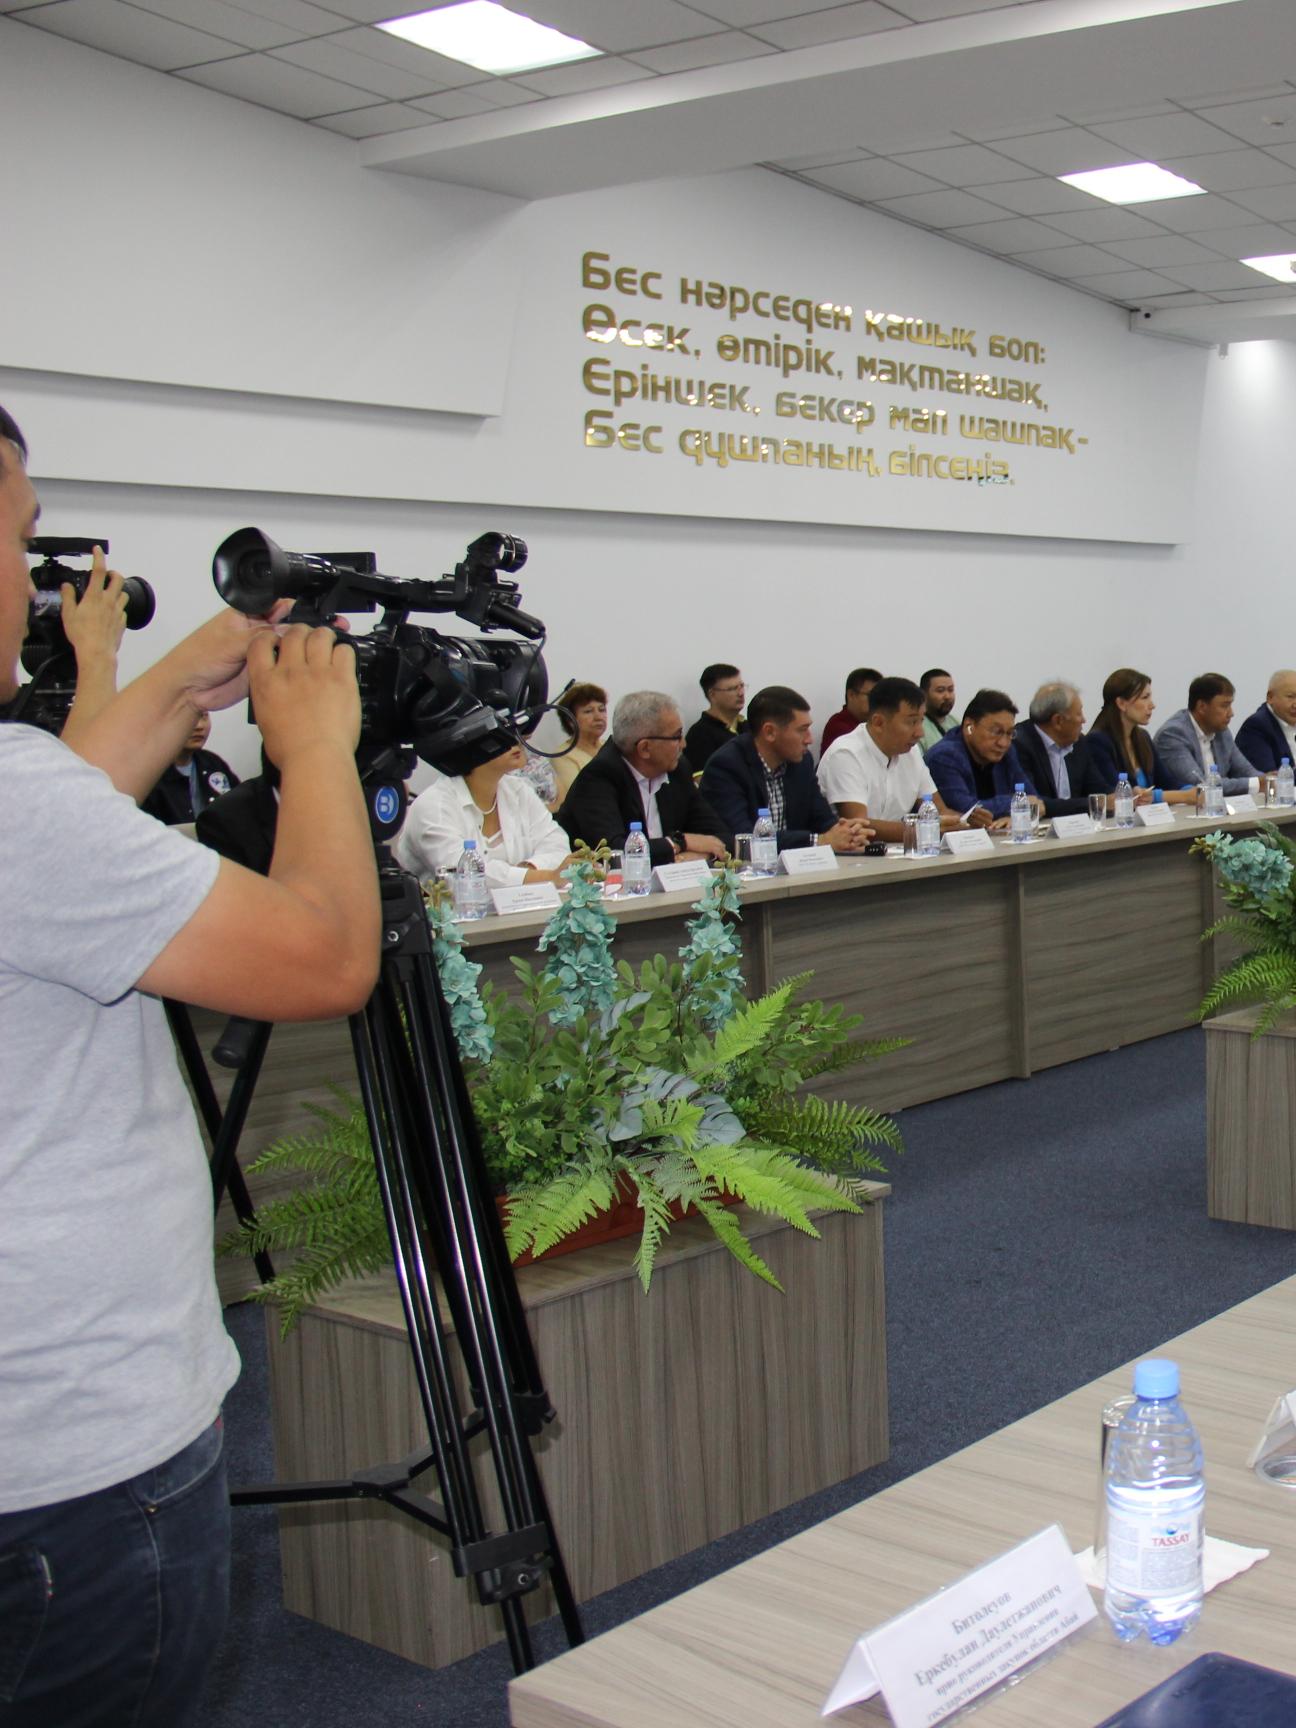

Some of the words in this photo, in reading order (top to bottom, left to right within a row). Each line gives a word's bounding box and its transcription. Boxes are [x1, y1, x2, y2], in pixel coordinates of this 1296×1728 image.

[581, 251, 663, 300] Бес
[680, 276, 852, 334] нәрседен
[865, 309, 977, 358] қашық
[584, 409, 663, 454] Бес
[776, 391, 876, 433] бекер
[1152, 1534, 1190, 1546] TASSAY
